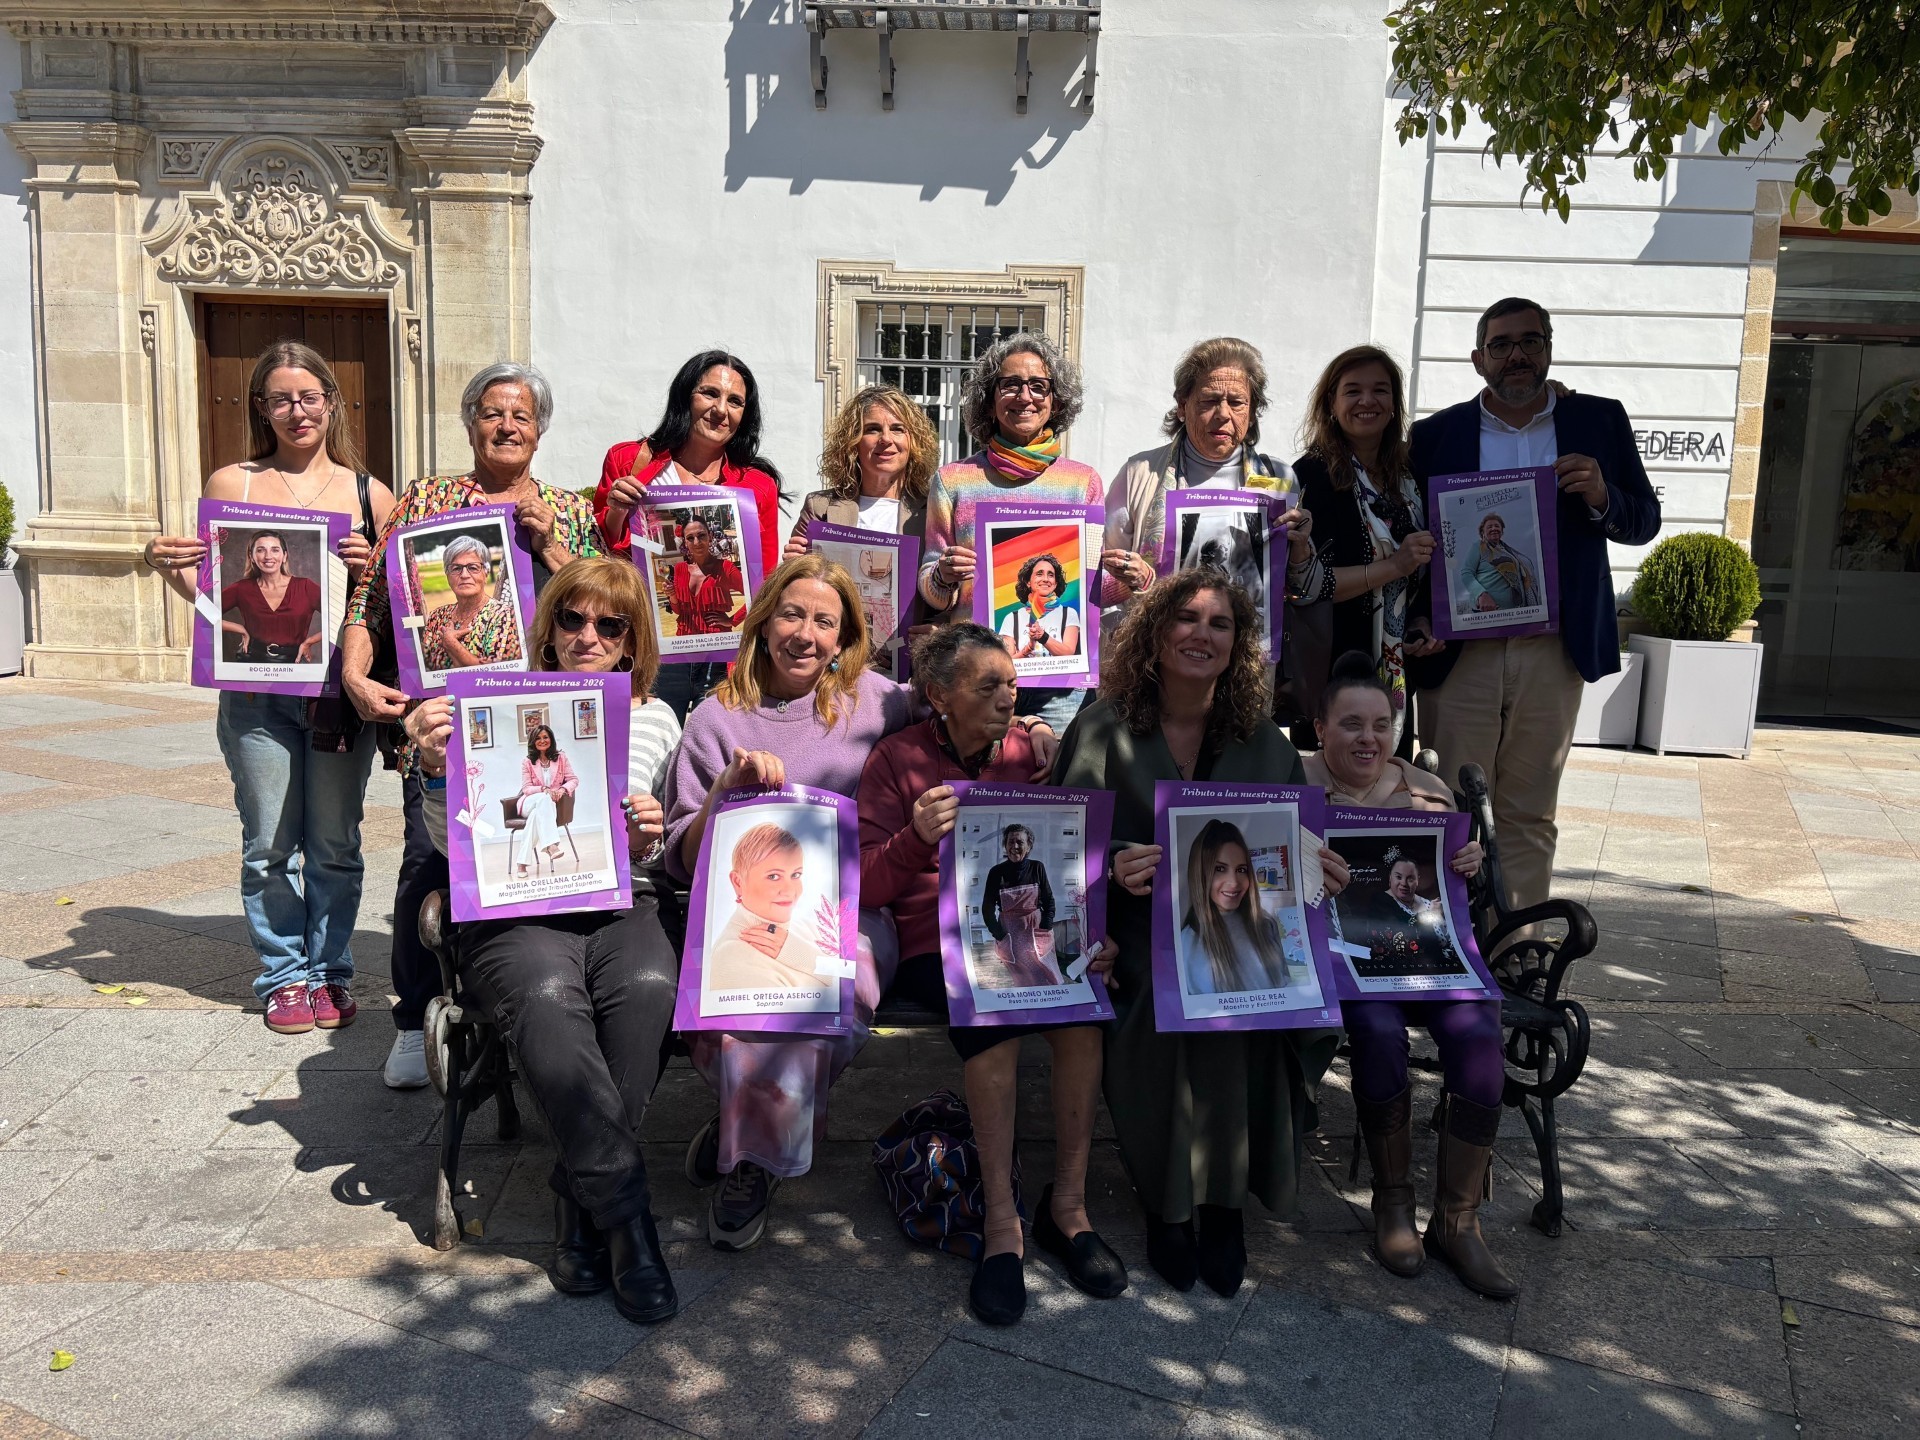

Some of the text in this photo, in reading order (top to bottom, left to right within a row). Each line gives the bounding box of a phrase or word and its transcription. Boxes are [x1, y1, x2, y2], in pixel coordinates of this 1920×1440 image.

[1634, 430, 1725, 456] EDERA
[222, 505, 253, 515] Tributo
[276, 513, 310, 521] nuestras
[822, 527, 842, 535] Tributo
[475, 678, 512, 686] Tributo
[523, 678, 537, 686] las
[729, 792, 756, 801] Tributo
[780, 791, 818, 801] nuestras
[821, 795, 838, 805] 2026
[969, 787, 1002, 796] Tributo
[1027, 792, 1066, 800] nuestras
[1068, 794, 1089, 802] 2026
[1182, 788, 1215, 797] Tributo
[1225, 789, 1238, 797] las
[1280, 791, 1300, 799] 2026
[1335, 812, 1366, 820] Tributo
[1390, 815, 1426, 823] nuestras
[1428, 817, 1448, 825] 2026
[531, 877, 569, 887] ORELLANA
[571, 873, 594, 881] CANO
[499, 887, 535, 898] Magistrada
[549, 882, 574, 891] Tribunal
[575, 879, 603, 889] Supremo
[719, 994, 750, 1003] MARIBEL
[1017, 990, 1042, 998] MONEO
